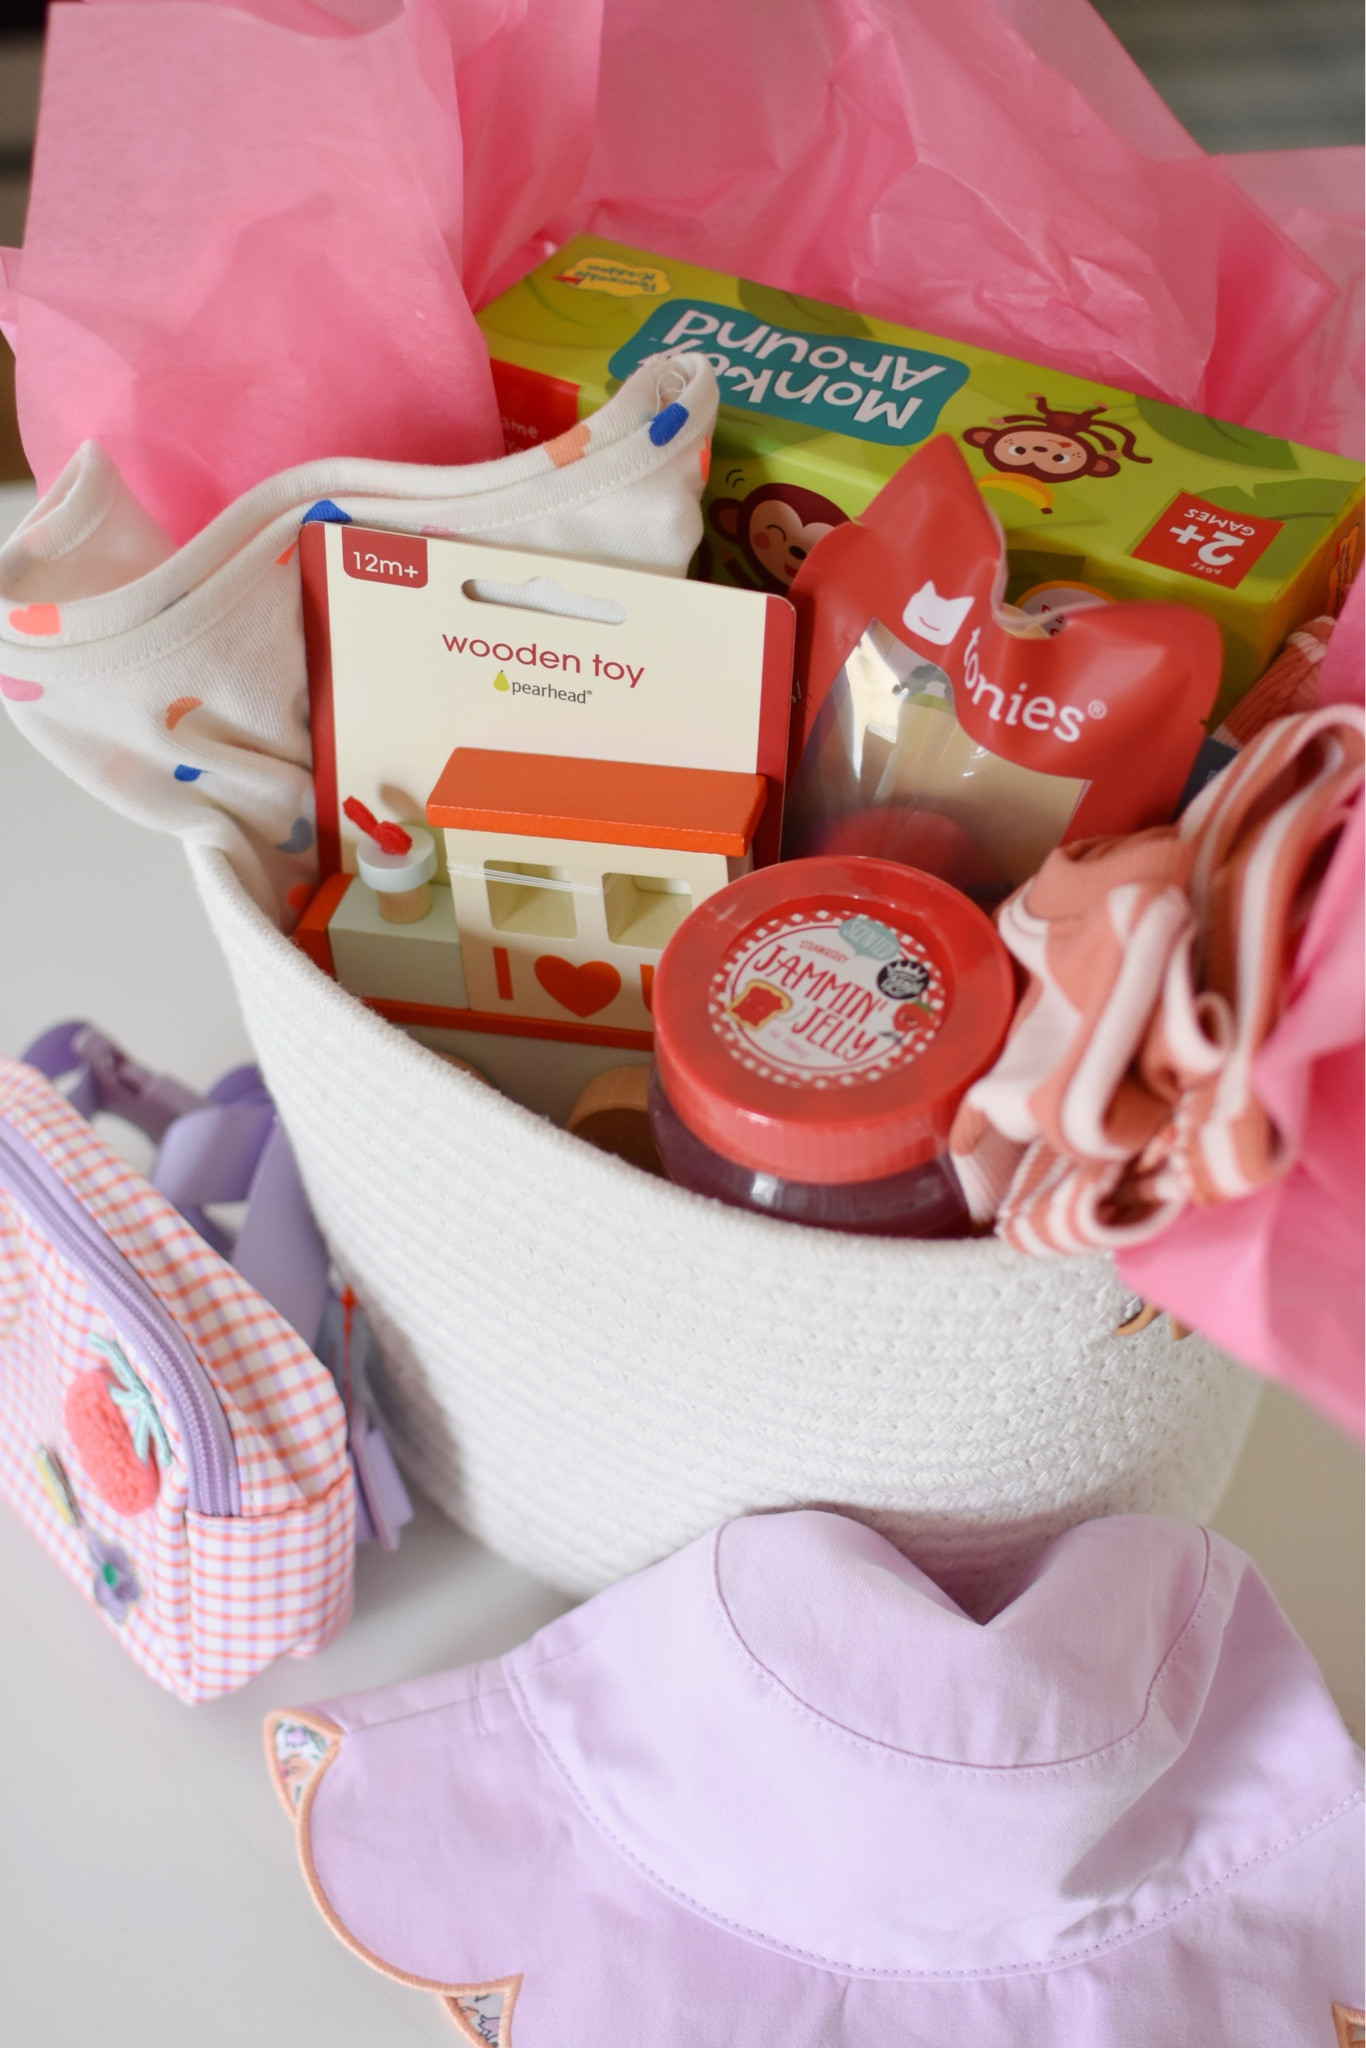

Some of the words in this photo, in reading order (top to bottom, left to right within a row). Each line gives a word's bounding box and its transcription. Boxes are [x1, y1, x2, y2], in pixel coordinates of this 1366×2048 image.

[661, 308, 947, 393] Around
[501, 416, 538, 440] ame
[1168, 523, 1246, 567] 2+
[1183, 507, 1256, 537] GAMES
[351, 550, 420, 580] 12m+
[1190, 561, 1222, 576] AGES
[441, 633, 581, 674] wooden
[592, 653, 646, 689] toy
[492, 946, 514, 1001] I
[753, 944, 888, 1024] JAMMIN'
[791, 1005, 878, 1062] JELLY
